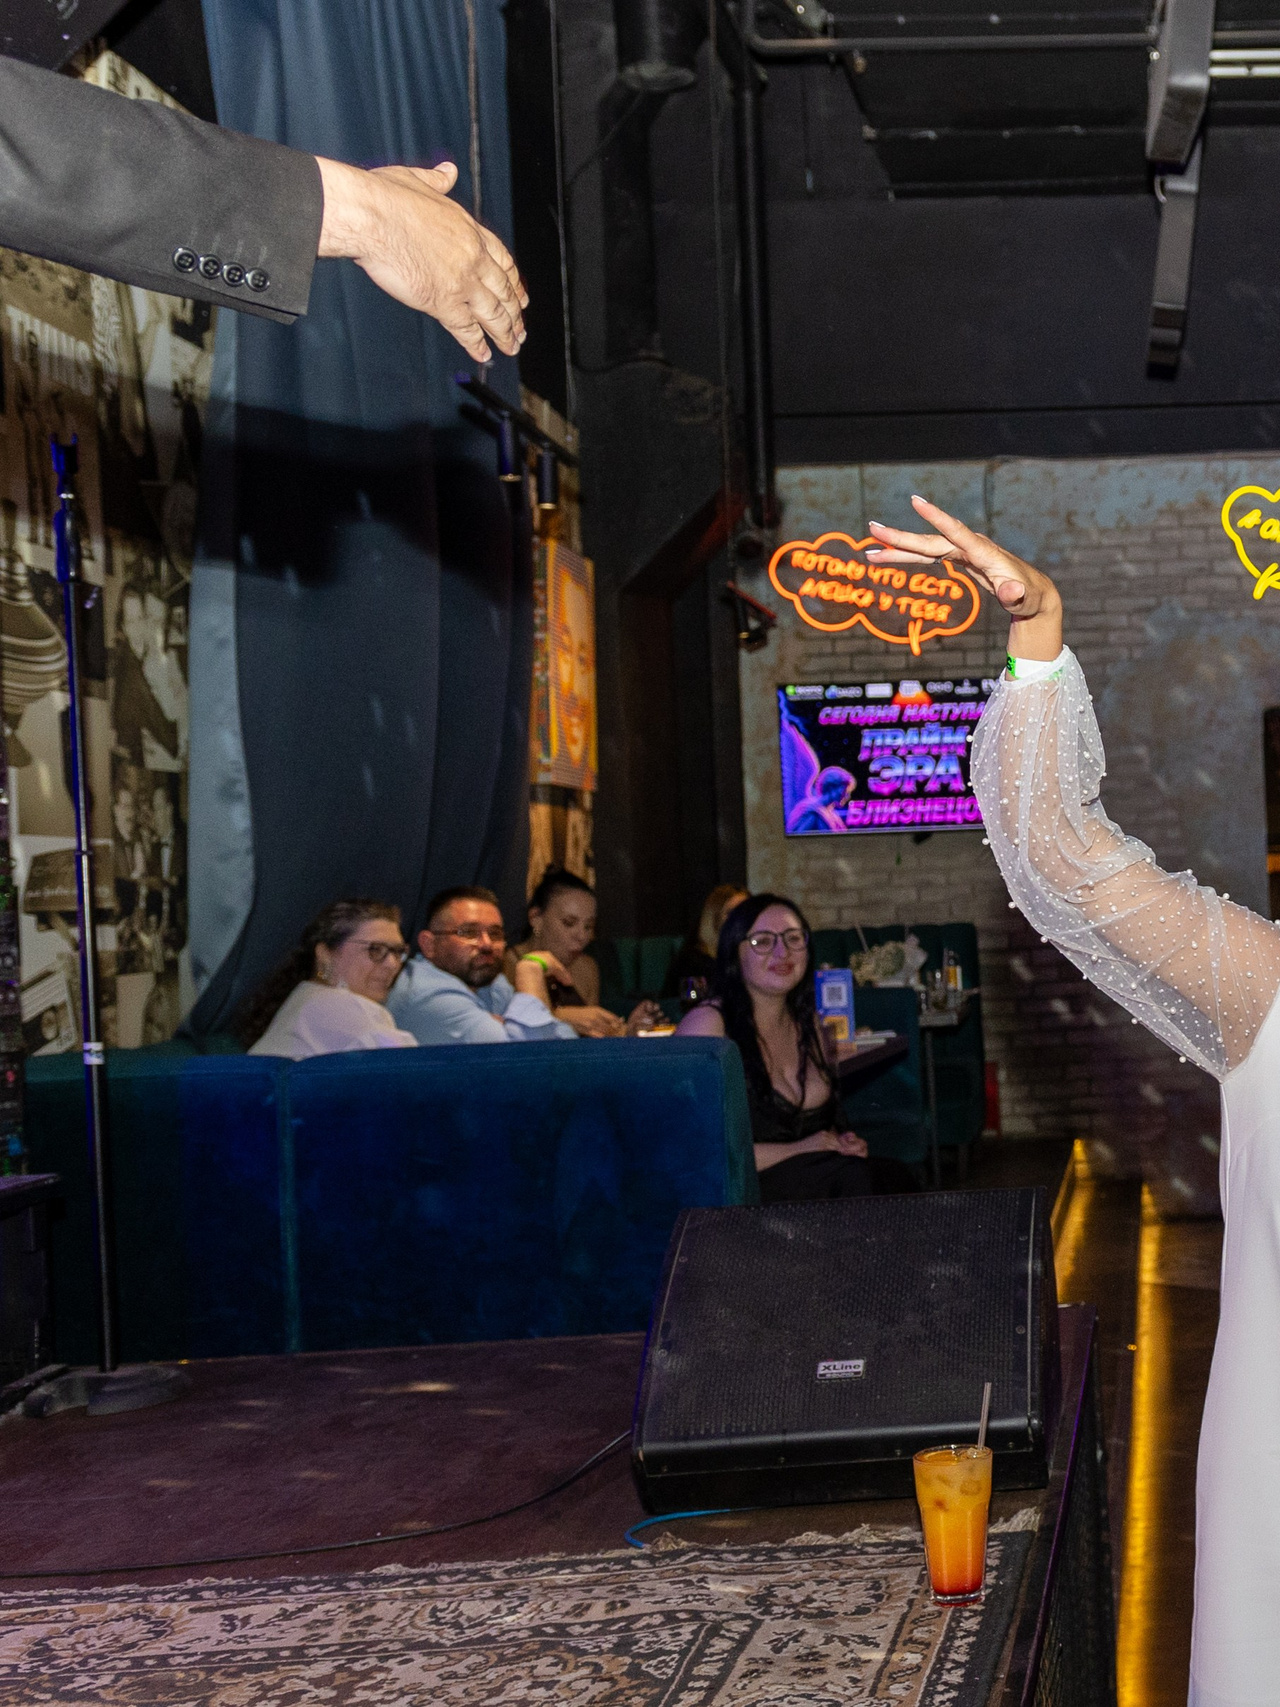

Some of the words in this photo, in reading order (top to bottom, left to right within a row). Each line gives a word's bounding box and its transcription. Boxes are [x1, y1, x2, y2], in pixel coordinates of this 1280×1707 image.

[791, 550, 867, 580] ПОТОМУ
[867, 564, 907, 589] ЧТО
[908, 573, 963, 600] ЕСТЬ
[895, 596, 952, 623] ТЕБЯ
[818, 705, 900, 725] СЕГОДНЯ
[902, 701, 985, 722] НАСТУПА
[858, 722, 970, 762] ПРАЙМ
[867, 754, 966, 795] ЭРА
[846, 796, 984, 826] БЛИЗНЕЦО
